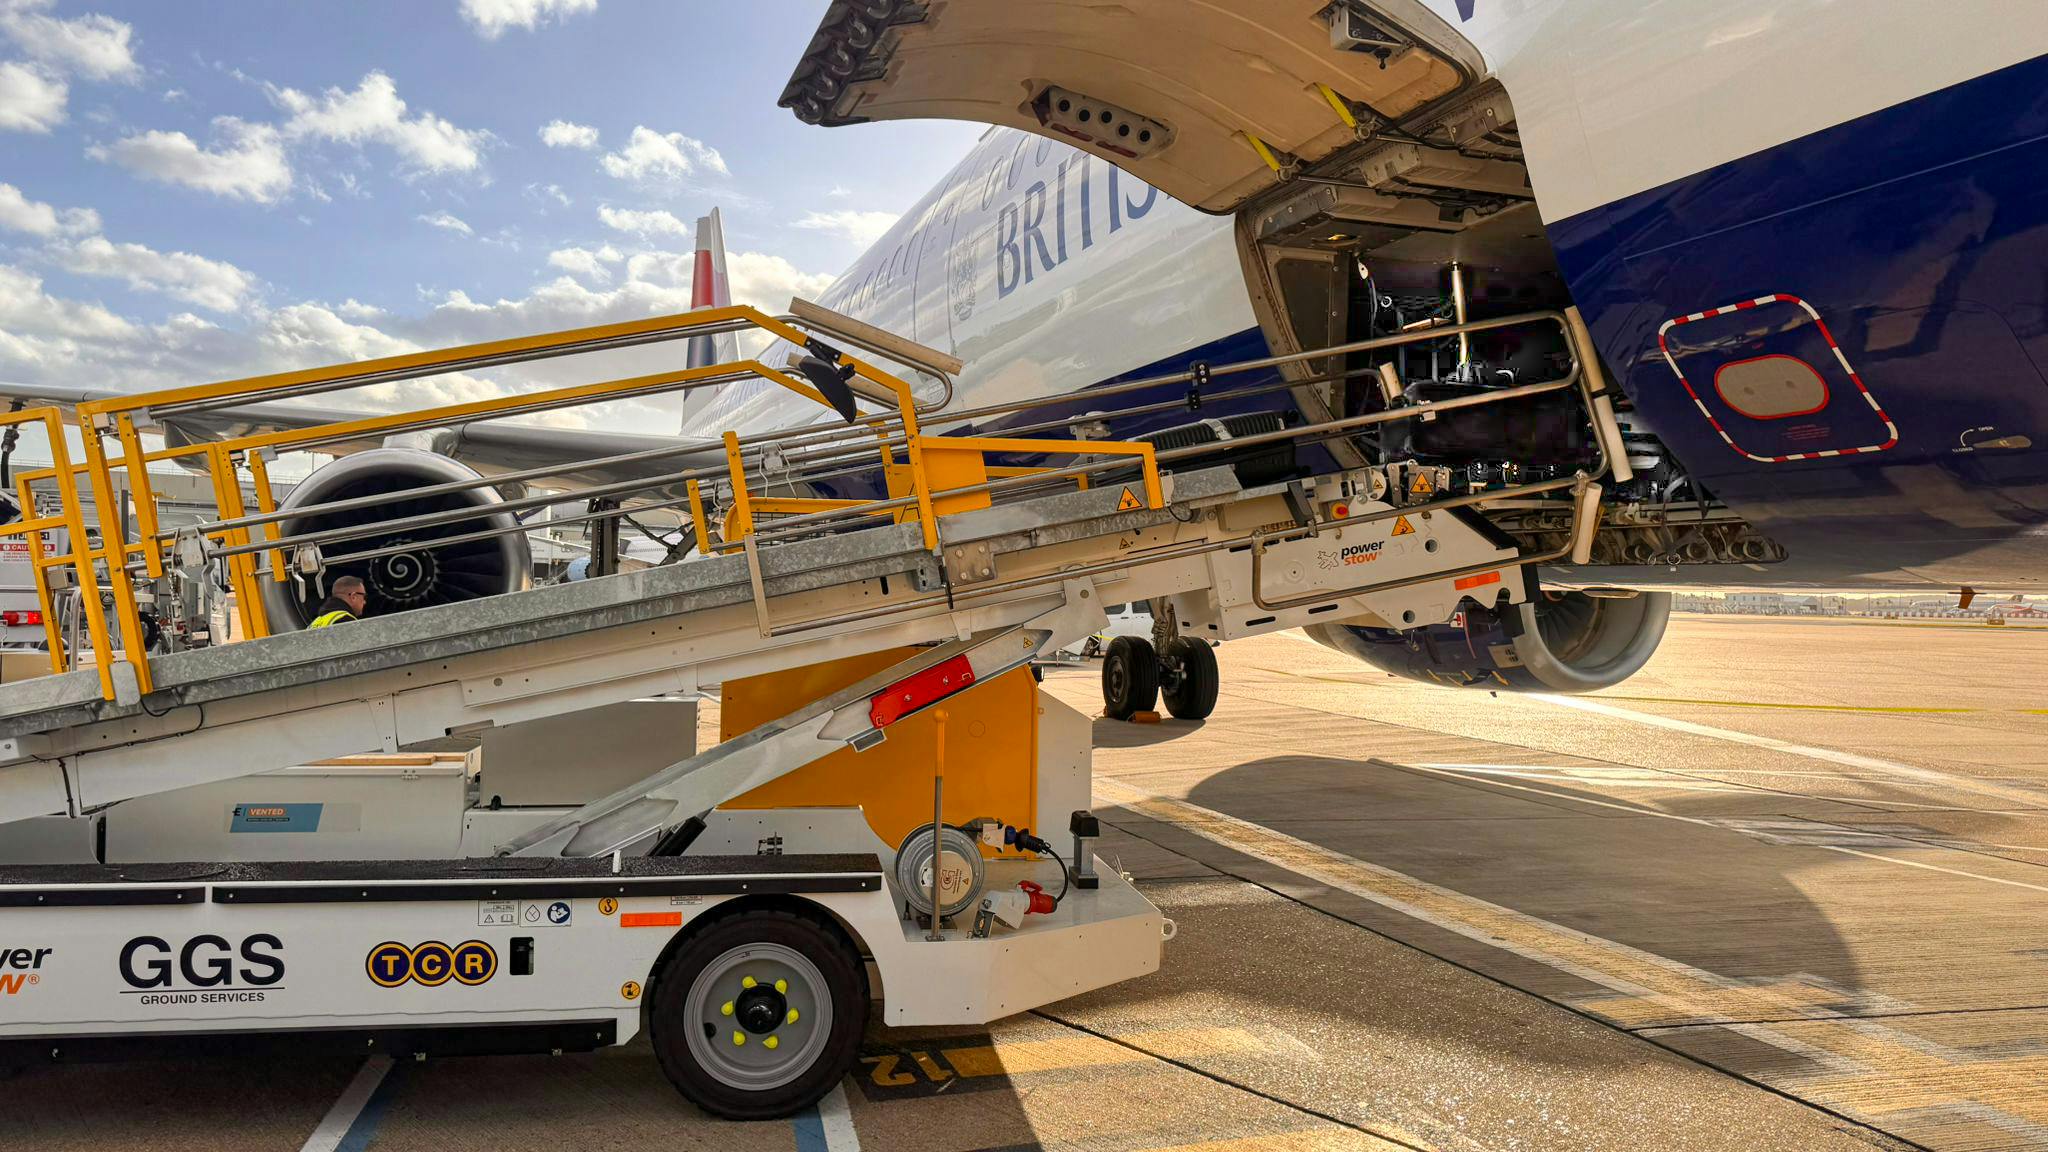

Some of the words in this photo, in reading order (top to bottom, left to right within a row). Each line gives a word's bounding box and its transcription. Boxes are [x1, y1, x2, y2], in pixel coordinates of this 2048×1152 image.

[997, 150, 1171, 300] BRITI
[1341, 540, 1384, 560] power
[119, 933, 285, 989] GGS
[140, 994, 197, 1005] GROUND
[201, 992, 265, 1003] SERVICES
